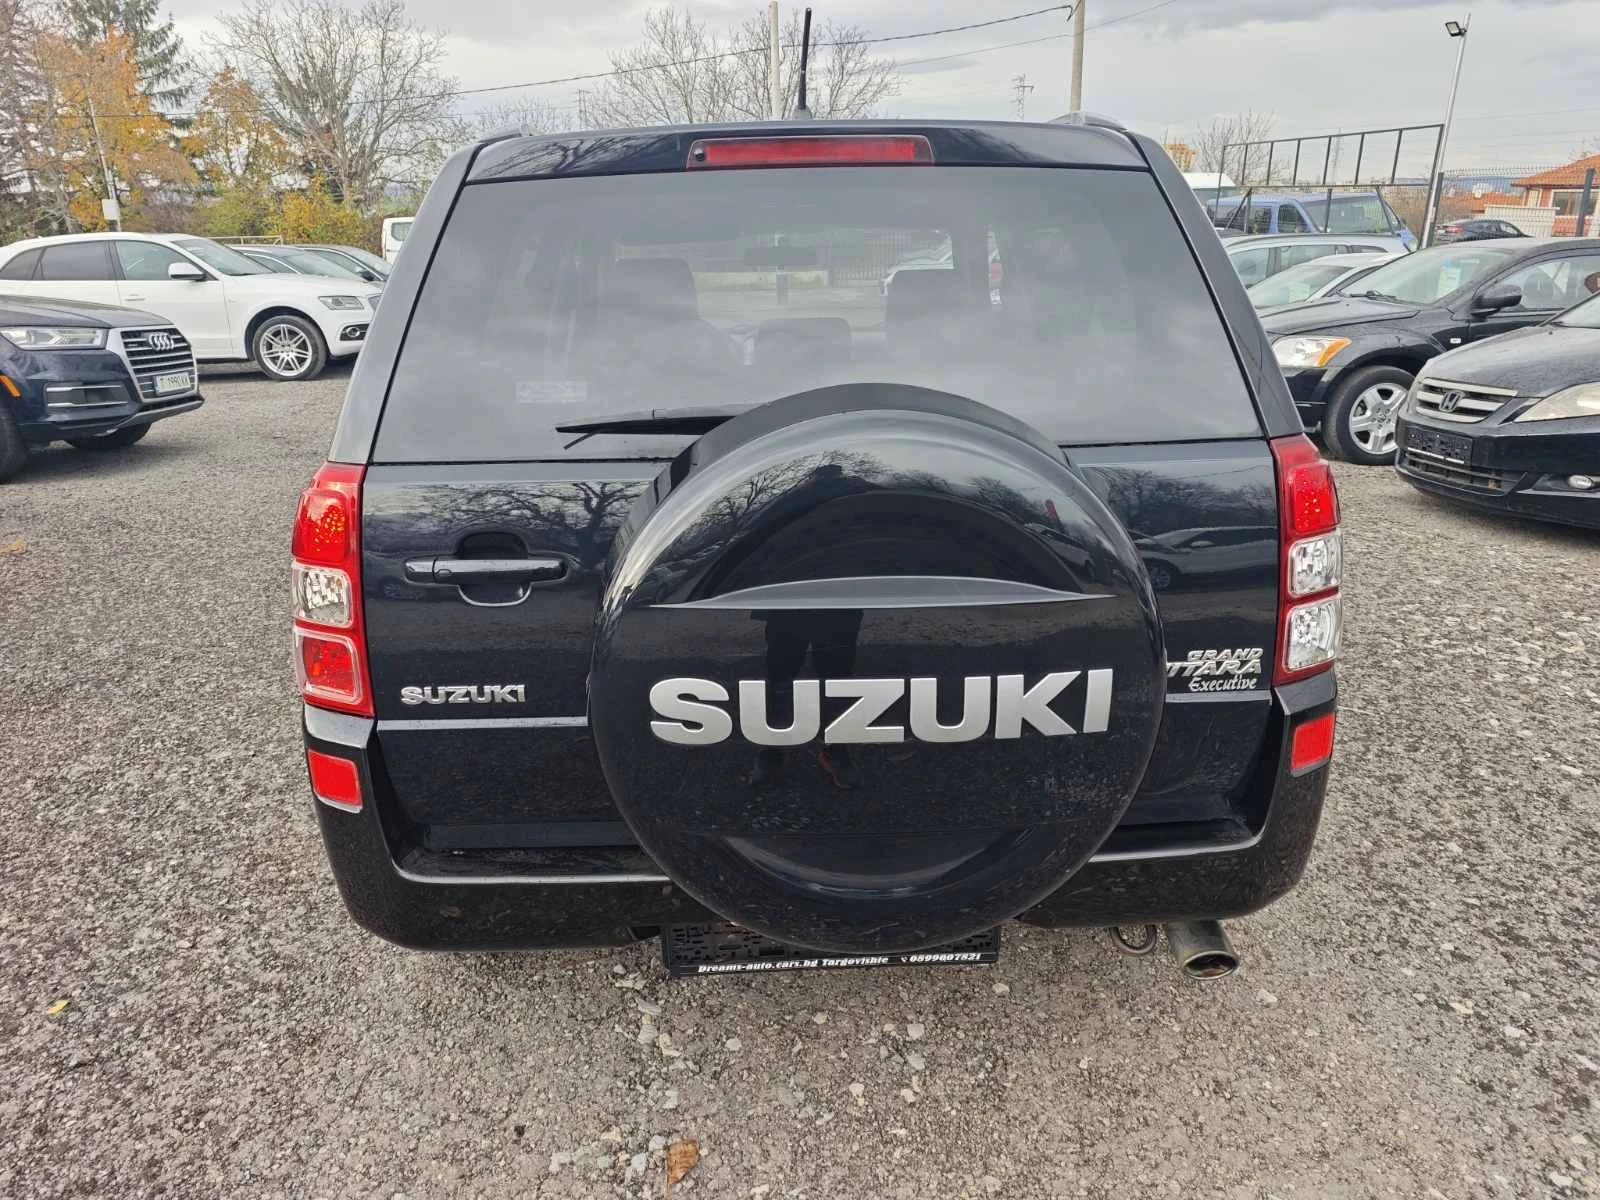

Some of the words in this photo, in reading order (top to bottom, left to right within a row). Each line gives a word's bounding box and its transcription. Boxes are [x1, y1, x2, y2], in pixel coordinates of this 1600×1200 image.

[1187, 647, 1264, 661] GRAND
[1188, 674, 1257, 692] Executive
[400, 684, 526, 706] SUZUKI
[650, 668, 1113, 746] SUZUKI
